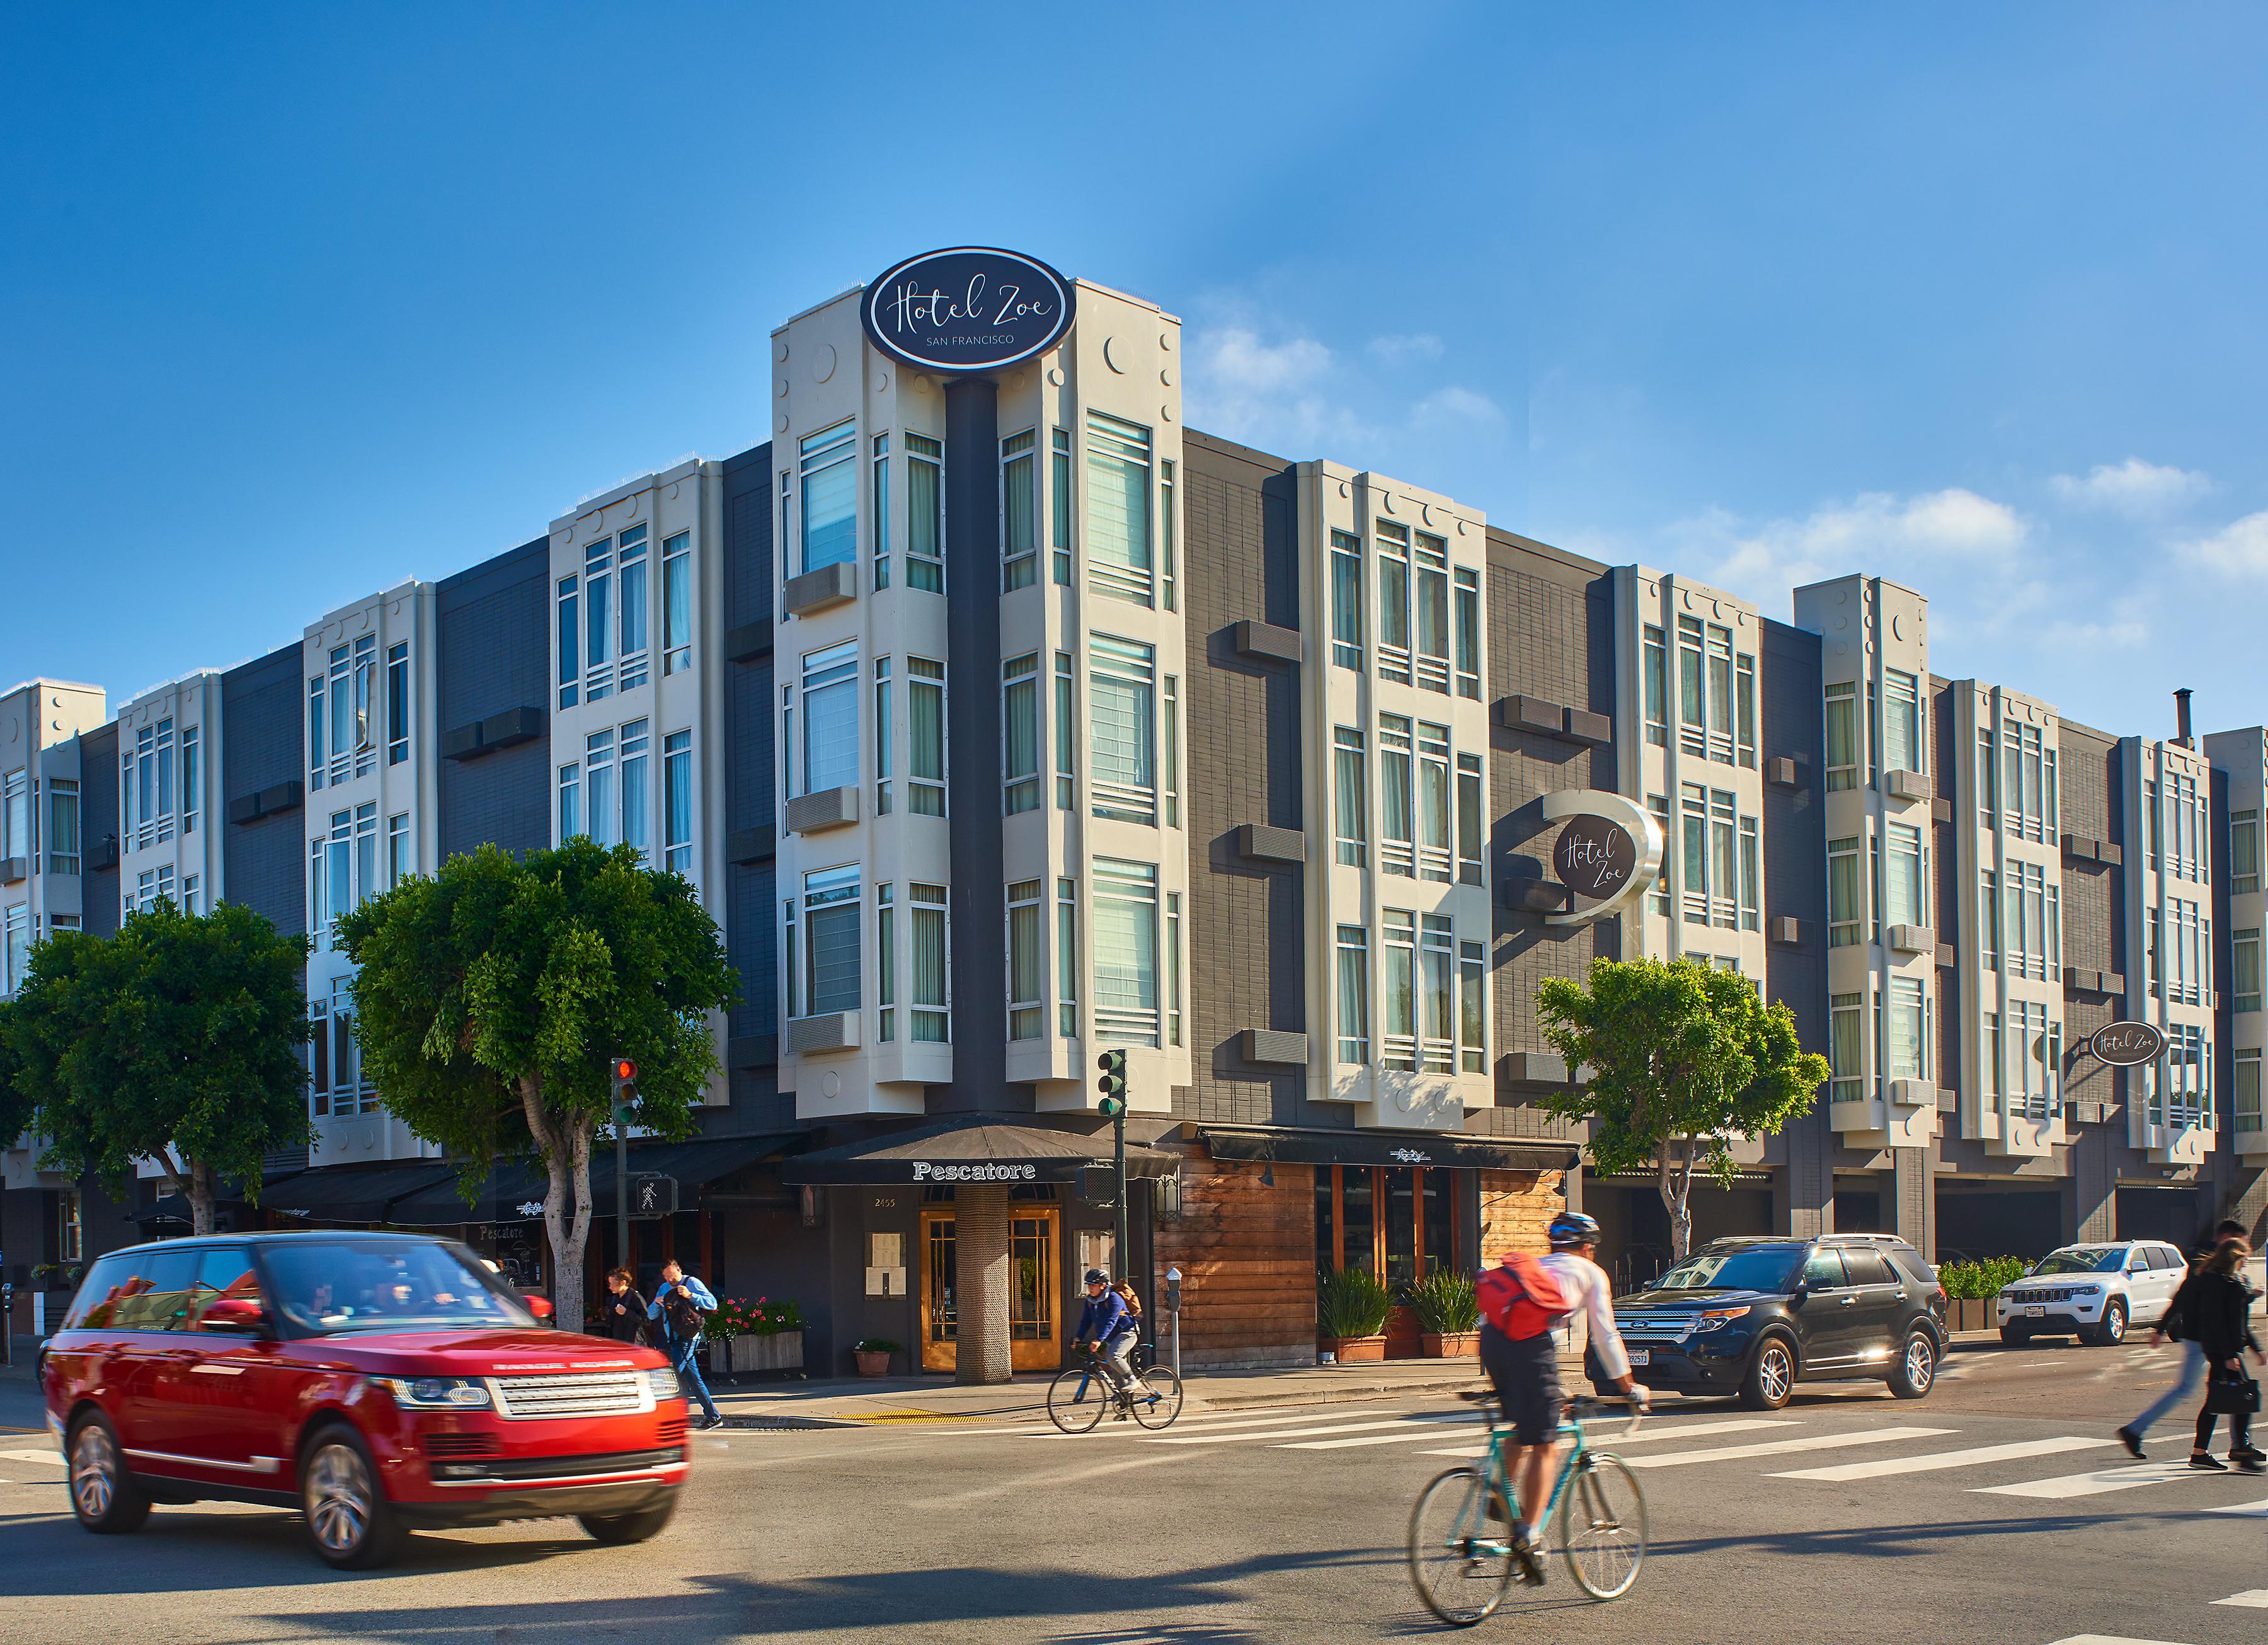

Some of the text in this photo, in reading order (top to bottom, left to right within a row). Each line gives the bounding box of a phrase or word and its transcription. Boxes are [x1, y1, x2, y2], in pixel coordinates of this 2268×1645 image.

[886, 273, 1053, 335] Hotel Zoe
[926, 335, 1014, 347] SAN FRANCISCO
[1562, 828, 1618, 869] Hotel
[1593, 860, 1626, 888] Zoe
[2098, 1030, 2155, 1053] Hotel Zoe
[913, 1162, 1036, 1181] Pescatore
[875, 1198, 895, 1207] 2455
[479, 1225, 524, 1241] Pescatore
[1628, 1355, 1647, 1363] 3925T1
